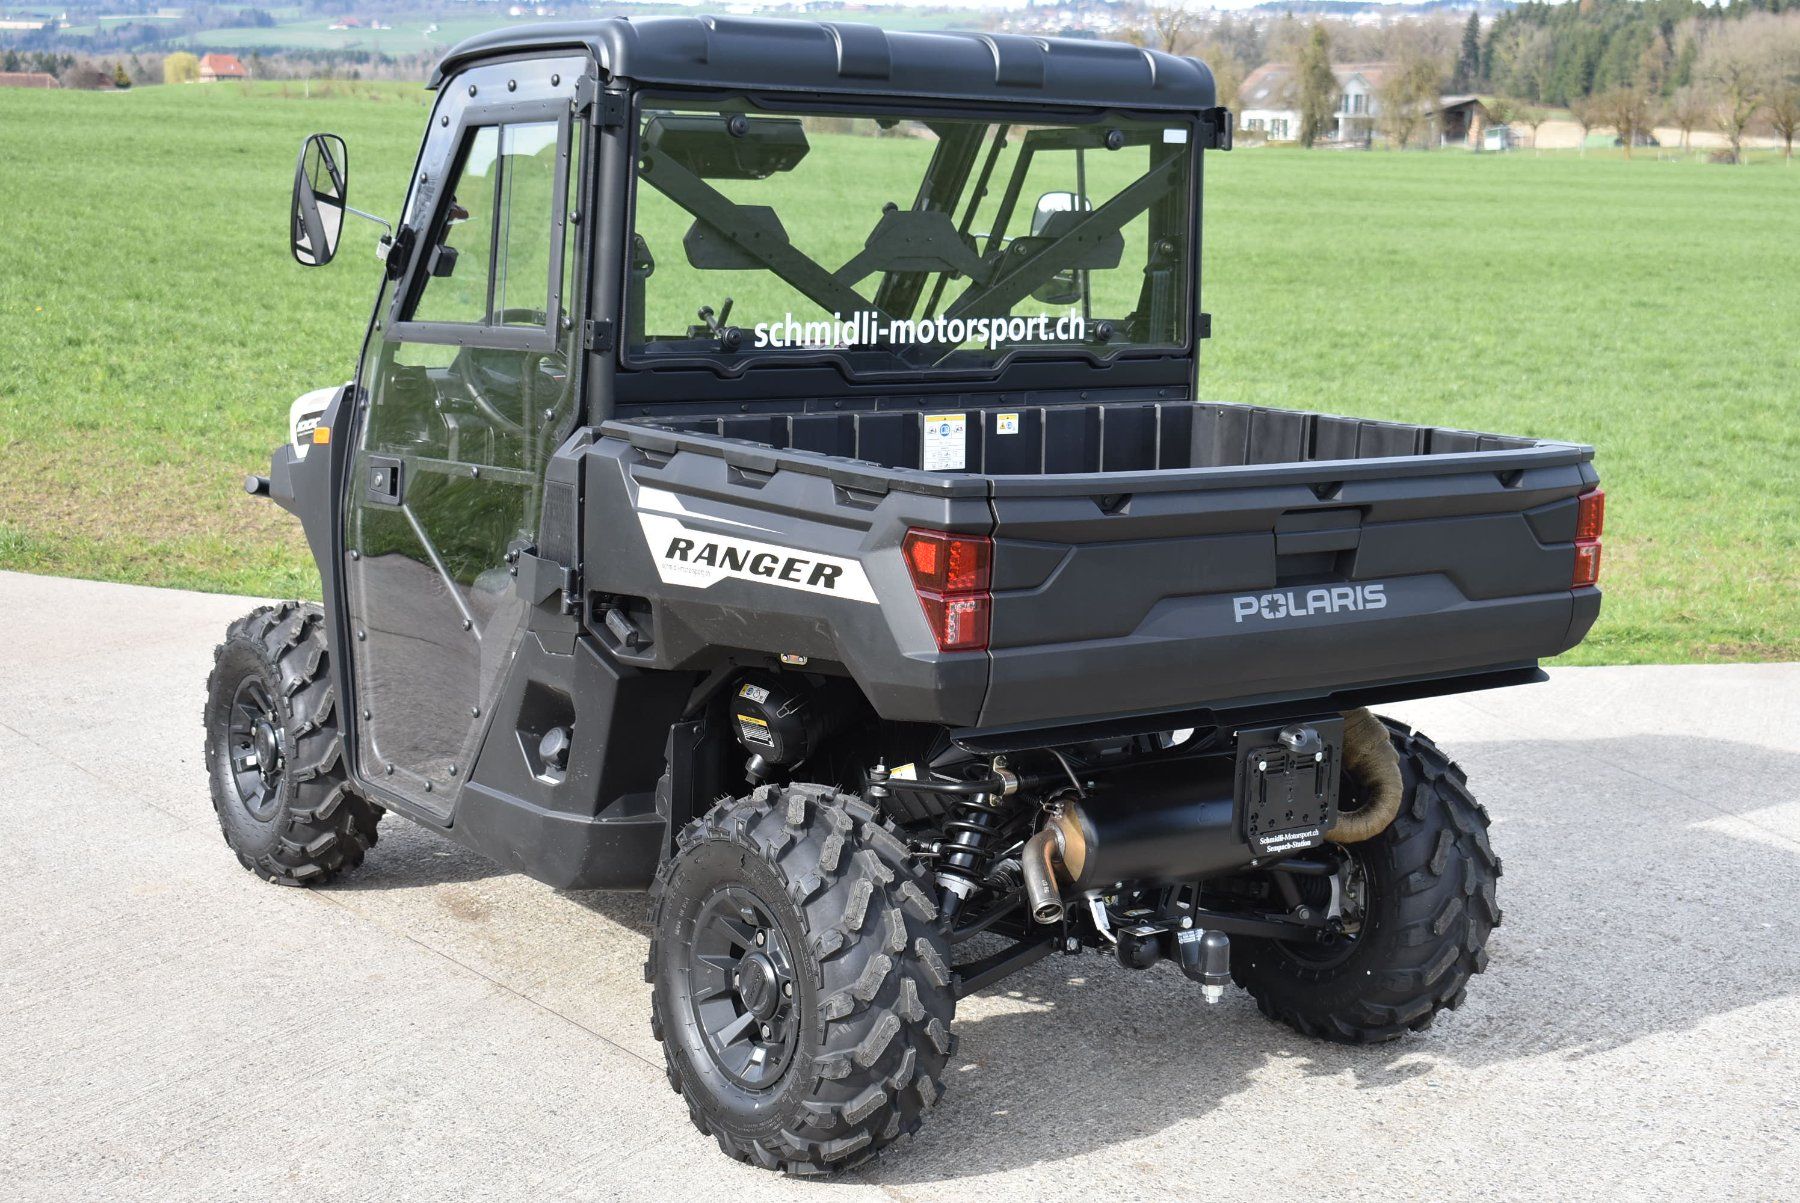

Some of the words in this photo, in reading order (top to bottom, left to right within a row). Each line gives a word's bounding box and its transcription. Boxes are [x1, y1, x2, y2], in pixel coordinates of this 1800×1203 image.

[754, 310, 1085, 349] schmidli-motorsport.ch
[665, 537, 843, 589] RANGER
[1233, 584, 1387, 623] POLARIS
